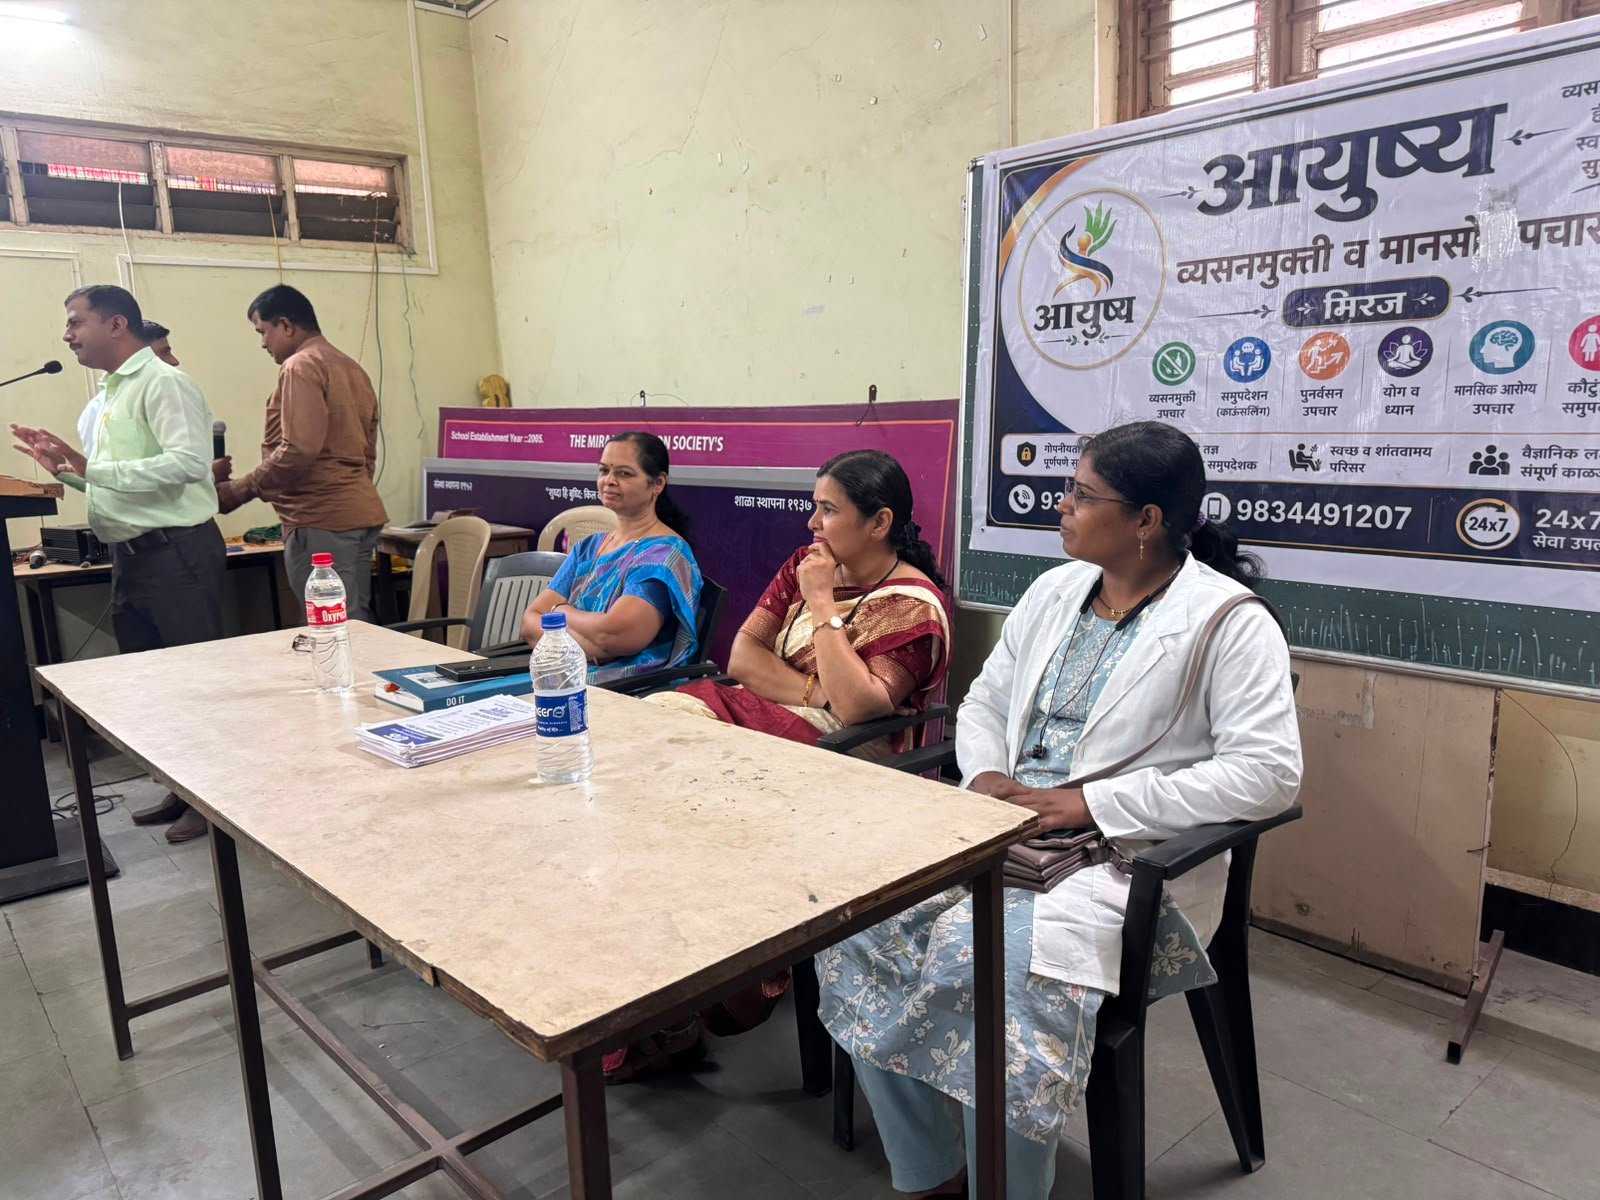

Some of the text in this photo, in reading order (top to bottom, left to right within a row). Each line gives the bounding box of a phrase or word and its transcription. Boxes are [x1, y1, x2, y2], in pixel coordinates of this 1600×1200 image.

[1561, 80, 1600, 98] व्यस
[1576, 135, 1600, 151] स्व
[1197, 103, 1508, 222] आयुष्य
[1581, 159, 1600, 179] सु
[1177, 234, 1333, 290] व्यसनमुक्ती
[1343, 240, 1370, 269] व
[1323, 291, 1406, 320] मिरज
[1033, 296, 1136, 339] आयुष्य
[1300, 386, 1344, 402] पुनर्वसन
[1383, 384, 1420, 397] योग व
[1454, 381, 1537, 396] मानसिक आरोग्य
[1567, 378, 1600, 397] कौटुं
[1149, 390, 1196, 406] व्यसनमुक्ती
[1221, 388, 1268, 405] समुपदेशन
[1157, 409, 1185, 418] उपचार
[1302, 406, 1338, 417] उपचार
[1385, 405, 1414, 415] ध्यान
[1472, 403, 1515, 415] उपचार
[1562, 402, 1600, 418] समुप
[451, 431, 470, 440] School
[470, 431, 509, 442] Establishment
[510, 433, 523, 443] Year
[569, 434, 587, 448] THE
[672, 435, 724, 452] SOCIETY'S
[1330, 446, 1359, 456] स्वच्छ
[1362, 447, 1371, 456] व
[1522, 444, 1580, 460] वैज्ञानिक
[1207, 457, 1258, 473] समुपदेशक
[1329, 460, 1365, 473] परिसर
[734, 495, 813, 512] शाळा स्थापना १९३७
[1040, 491, 1065, 510] 93
[1236, 499, 1413, 531] 9834491207
[1535, 508, 1600, 530] 24x7
[1468, 516, 1508, 533] 24x7
[1532, 530, 1567, 549] सेवा
[446, 695, 465, 706] DO IT
